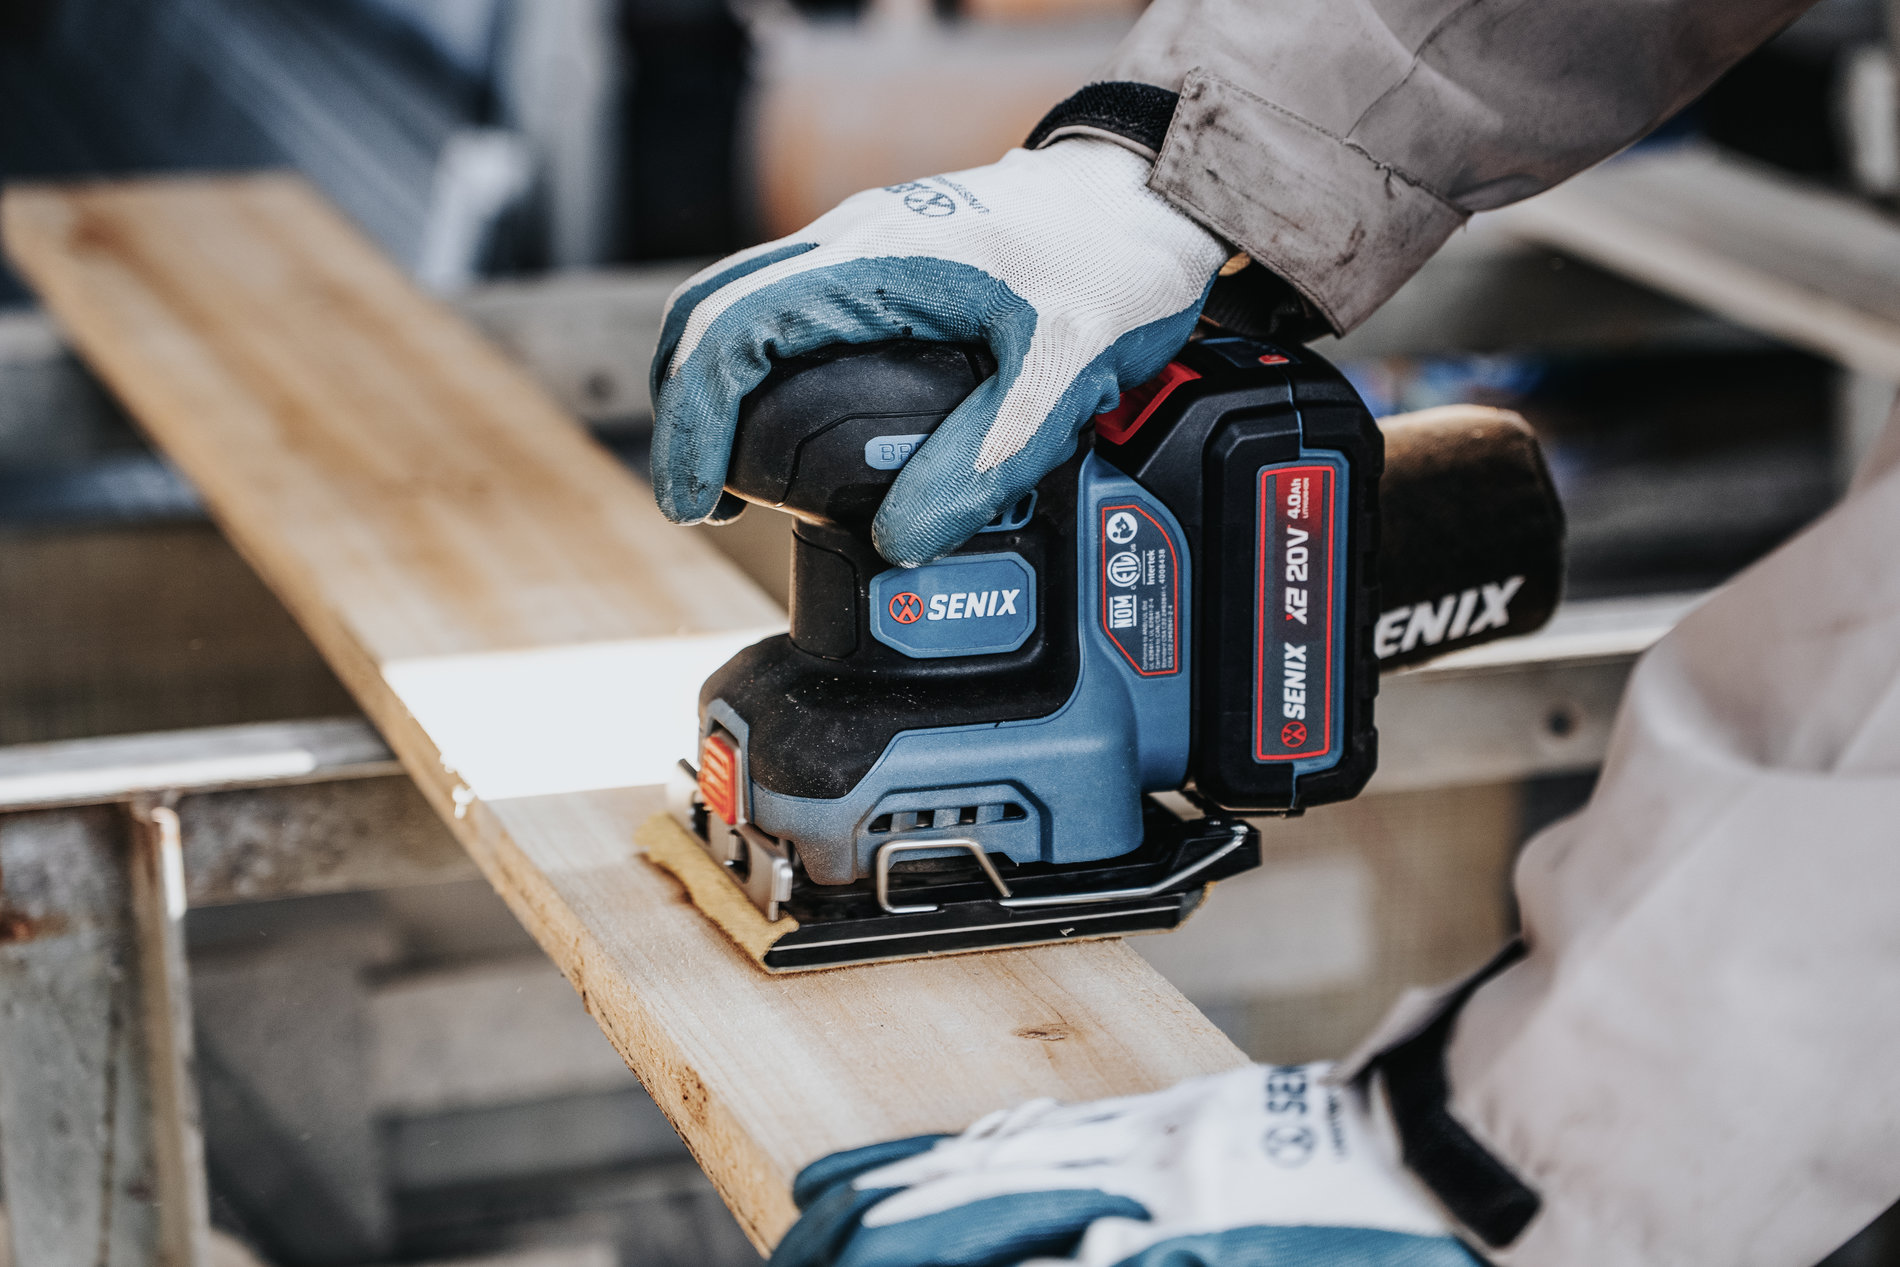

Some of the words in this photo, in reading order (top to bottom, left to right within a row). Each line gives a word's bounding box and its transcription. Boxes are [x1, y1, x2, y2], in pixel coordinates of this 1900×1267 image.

[879, 442, 922, 463] BR
[1287, 478, 1301, 519] 4.0Ah
[1146, 549, 1156, 585] Intertek
[1286, 527, 1309, 581] 20V
[926, 589, 1021, 621] SENIX
[1113, 595, 1133, 628] NOM
[1285, 587, 1308, 625] X2
[1283, 642, 1306, 720] SENIX
